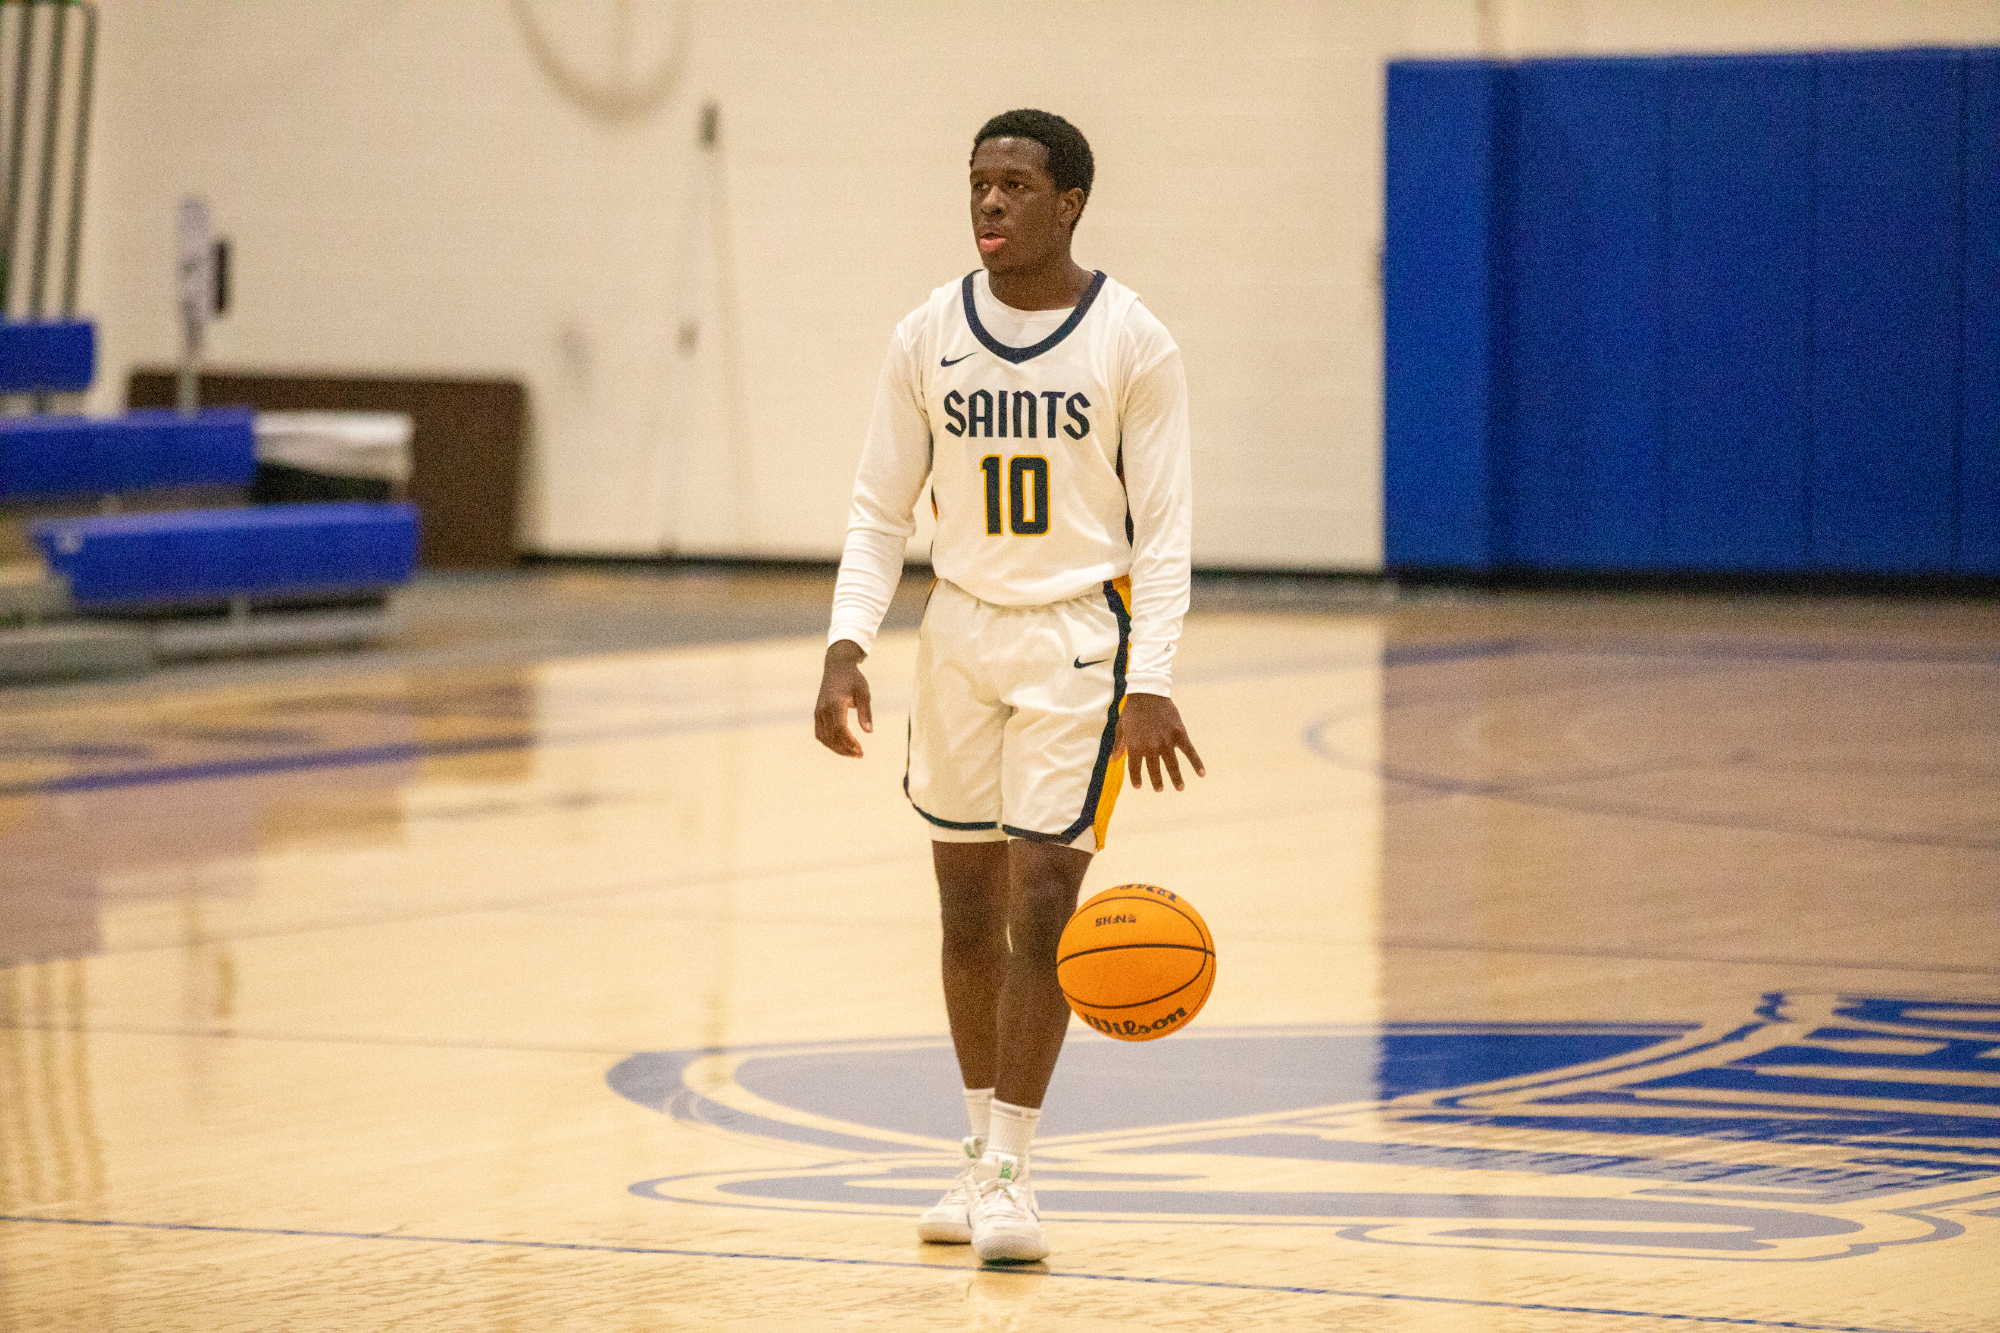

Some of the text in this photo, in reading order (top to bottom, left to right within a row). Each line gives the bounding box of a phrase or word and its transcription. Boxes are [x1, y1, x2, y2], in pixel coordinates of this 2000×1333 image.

[943, 389, 1092, 440] SAINTS
[980, 454, 1051, 537] 10
[1082, 1007, 1188, 1036] Wilson
